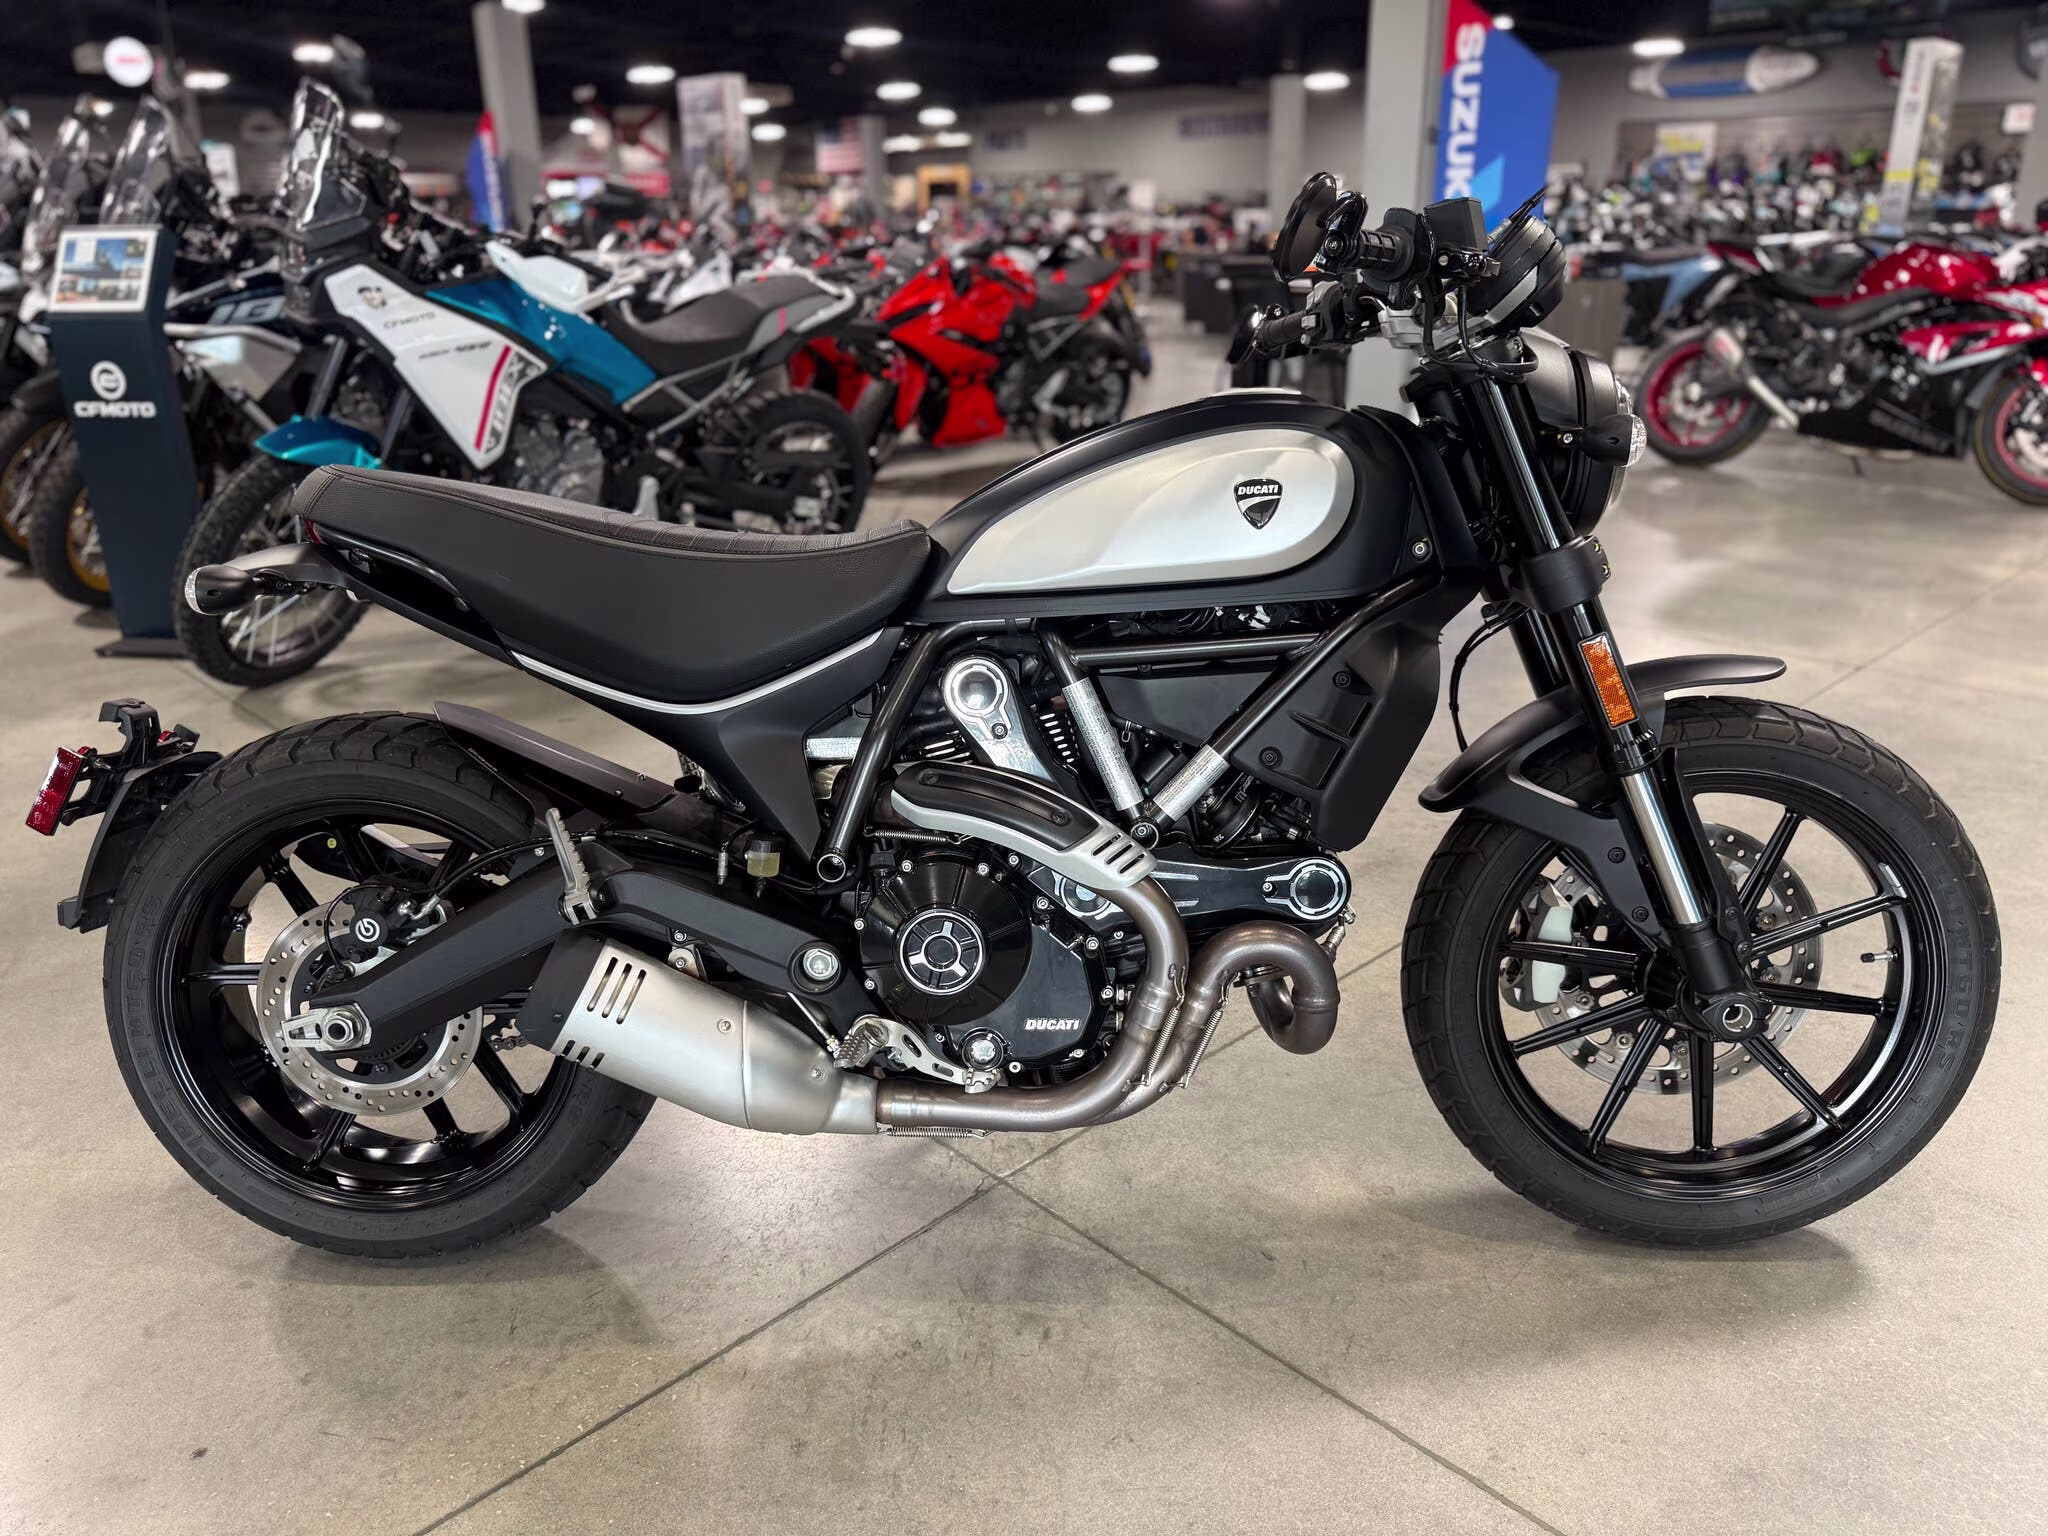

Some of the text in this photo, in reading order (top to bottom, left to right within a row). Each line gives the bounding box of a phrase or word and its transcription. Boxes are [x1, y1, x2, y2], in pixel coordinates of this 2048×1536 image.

[1443, 21, 1486, 200] SUZUK
[73, 400, 157, 418] CFMOTO
[1237, 484, 1279, 496] DUCATI
[1025, 1018, 1080, 1031] DUCATI
[135, 1047, 221, 1169] PIRELLI
